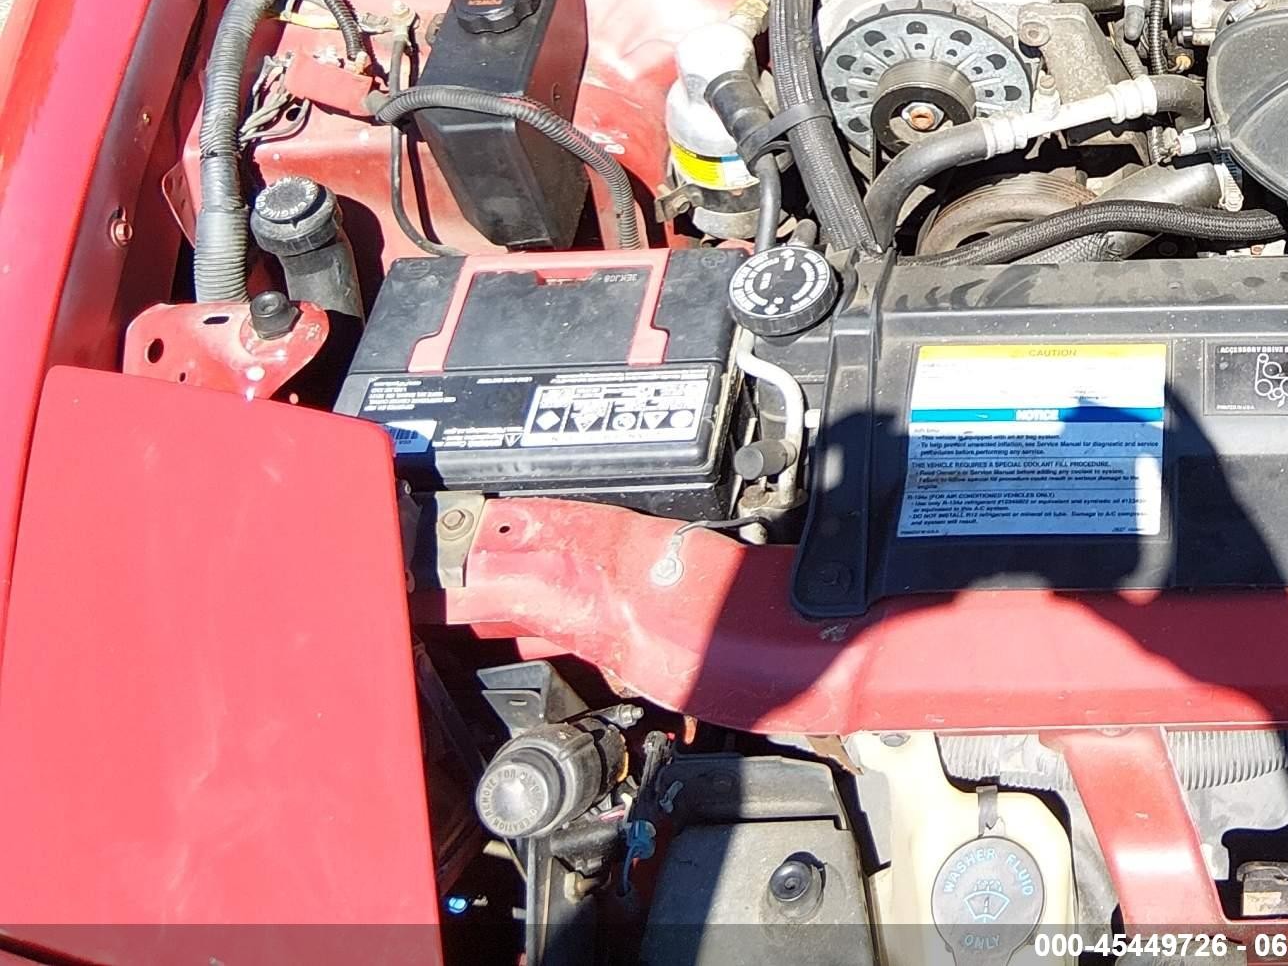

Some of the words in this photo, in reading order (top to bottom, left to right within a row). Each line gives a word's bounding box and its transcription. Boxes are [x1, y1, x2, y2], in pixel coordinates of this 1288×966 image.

[1028, 348, 1078, 357] CAUTION
[943, 848, 998, 893] WASHER
[1005, 854, 1035, 896] FLUID
[964, 934, 1000, 949] ONLY
